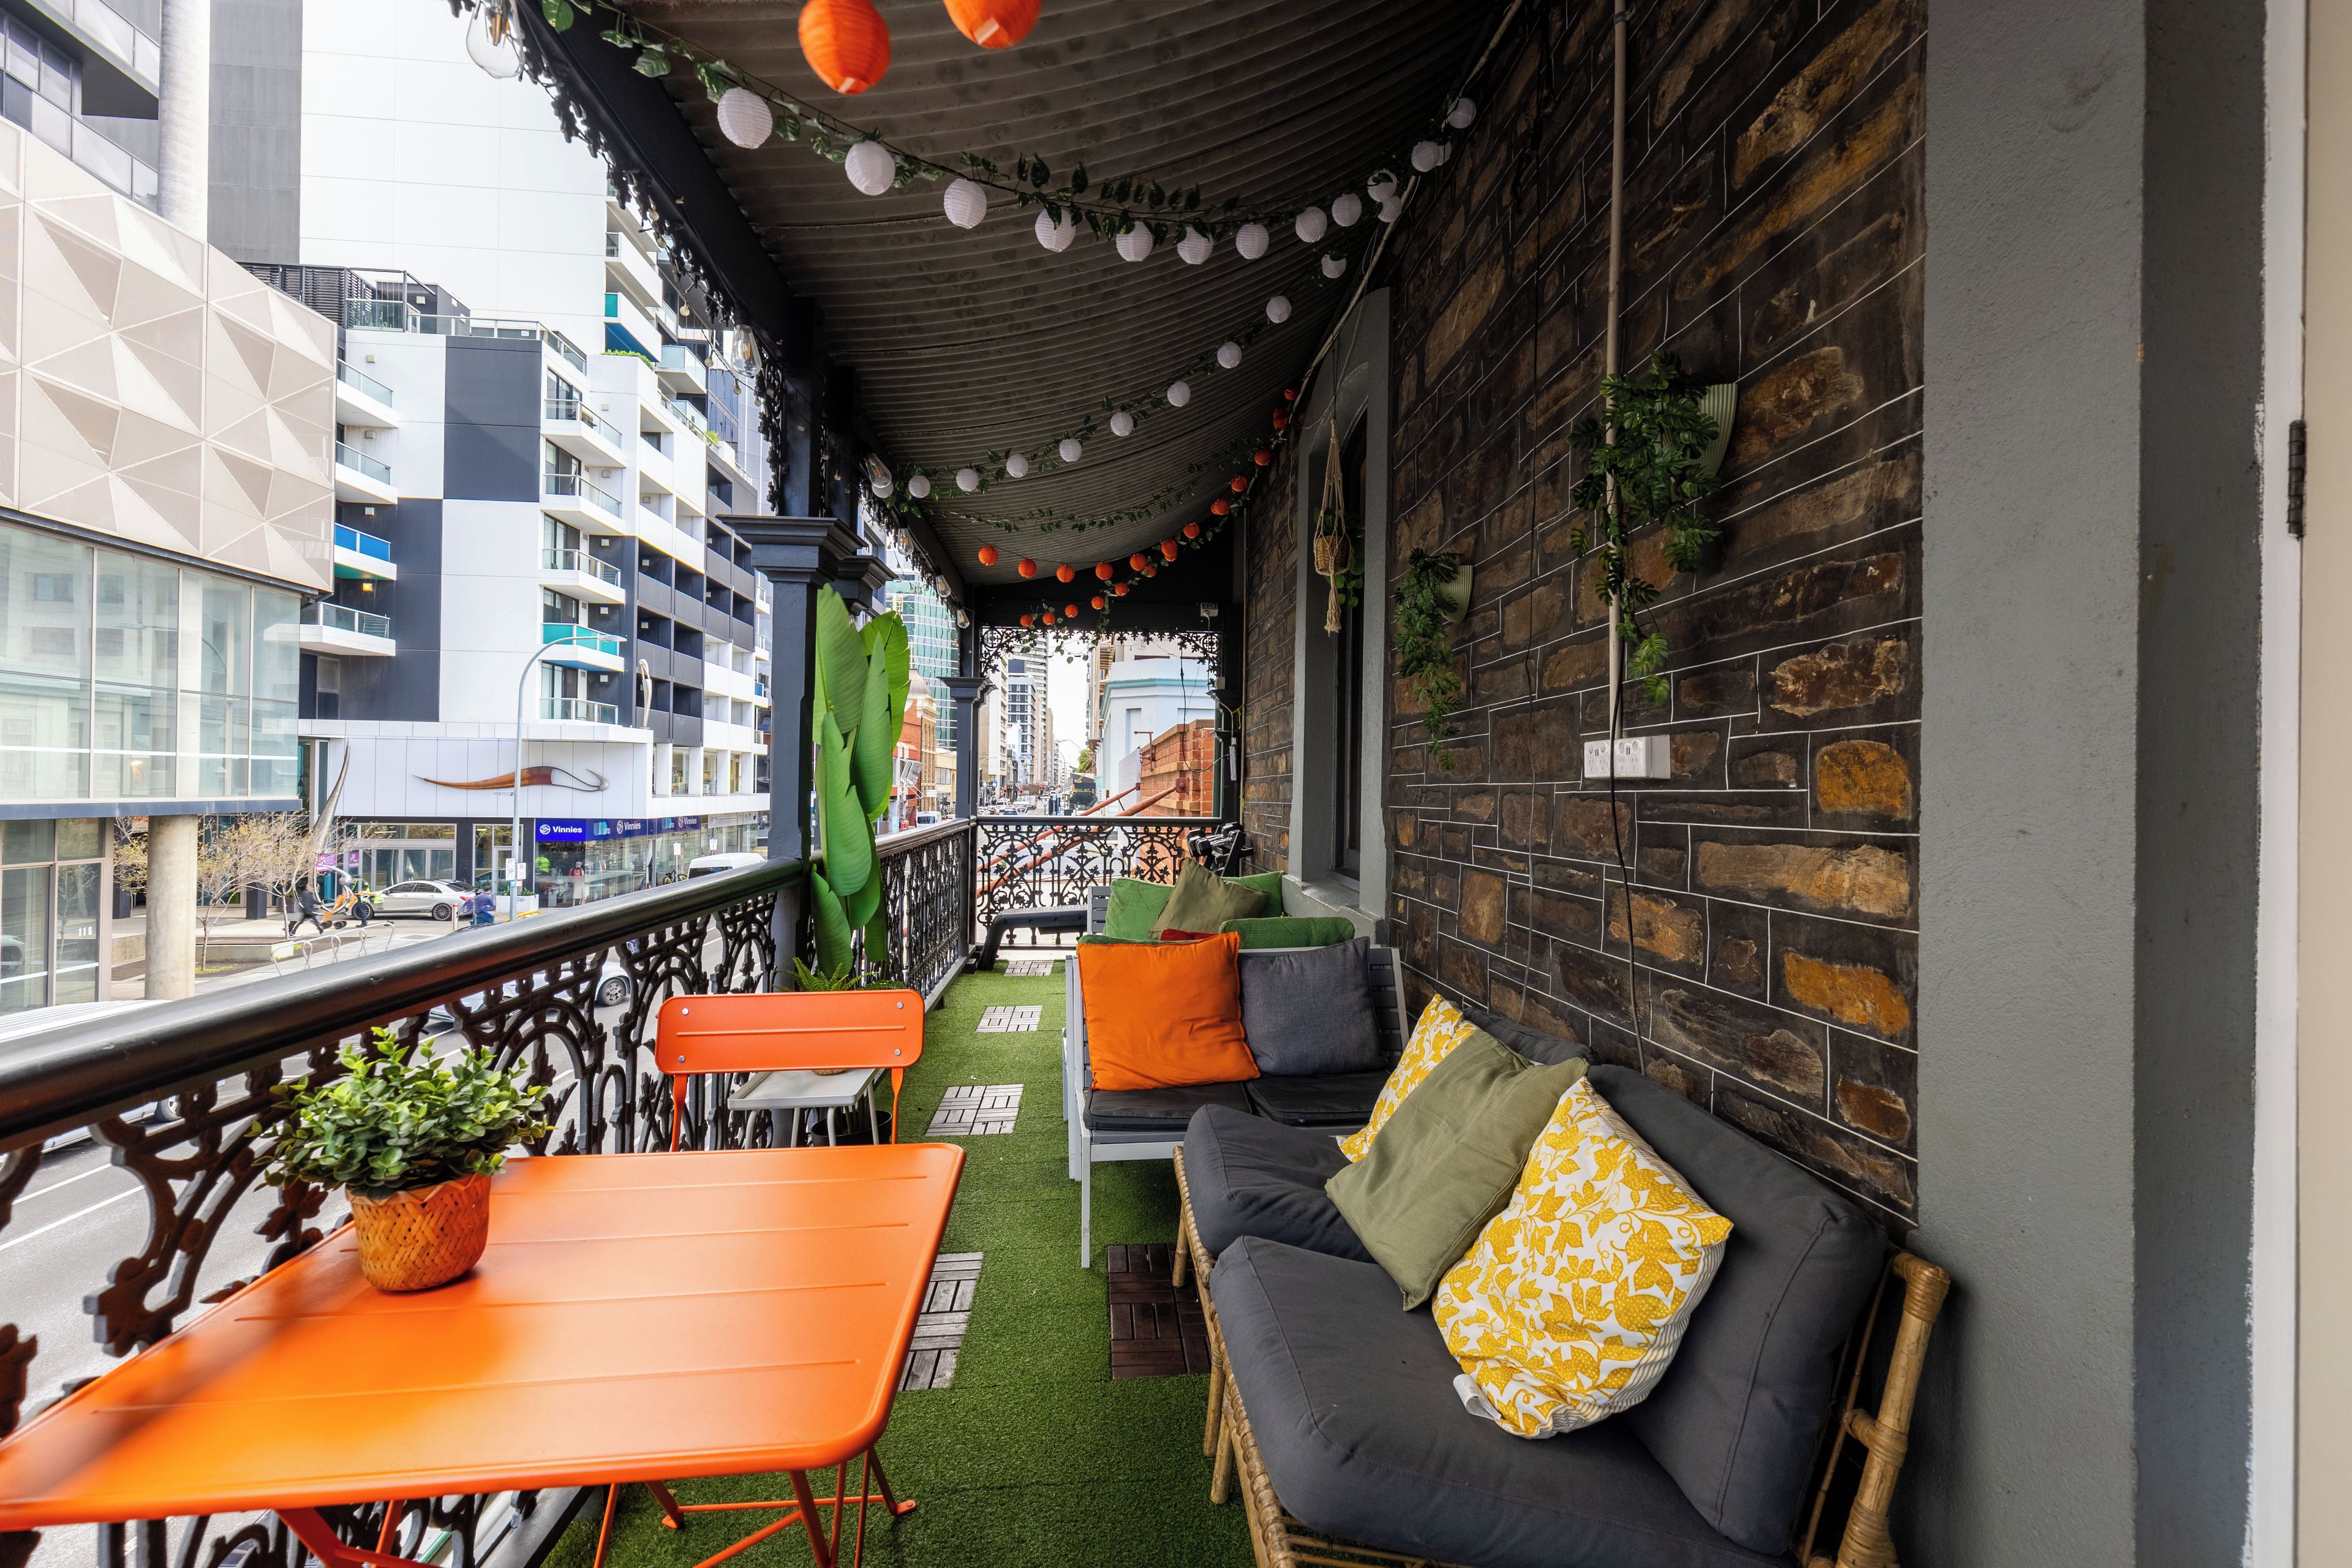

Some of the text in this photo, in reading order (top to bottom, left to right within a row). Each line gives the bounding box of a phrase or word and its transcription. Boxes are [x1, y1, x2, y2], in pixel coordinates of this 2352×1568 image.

[684, 816, 697, 825] Vinnies
[624, 821, 641, 831] Vinnies
[78, 926, 92, 937] 116
